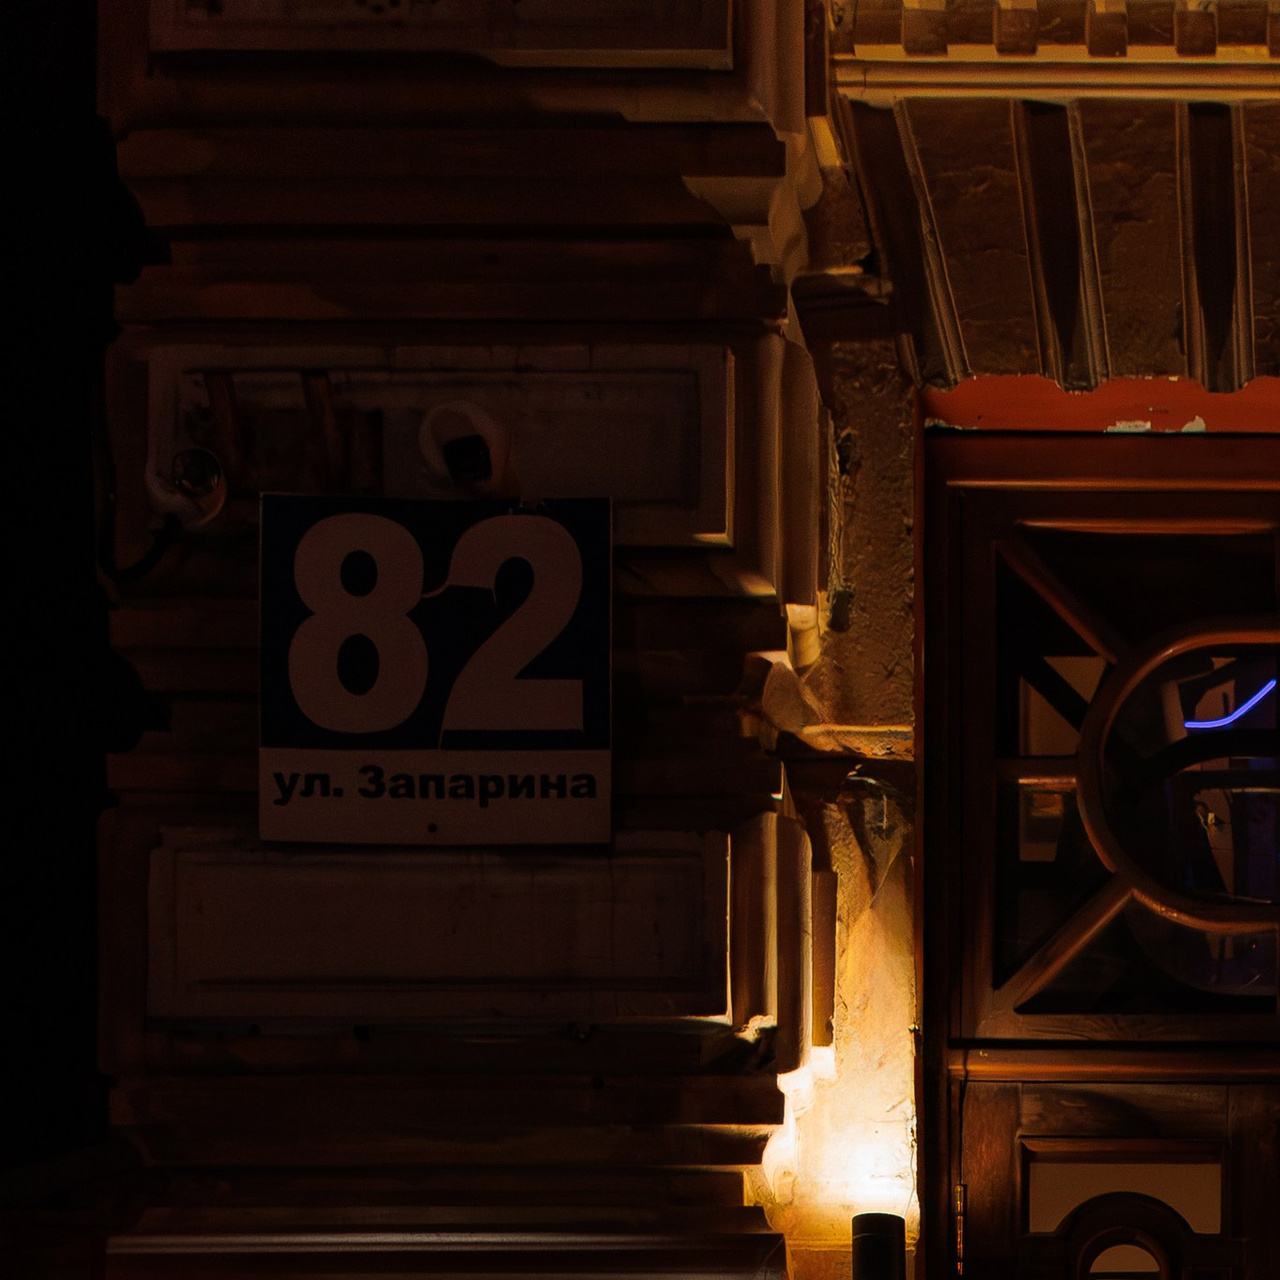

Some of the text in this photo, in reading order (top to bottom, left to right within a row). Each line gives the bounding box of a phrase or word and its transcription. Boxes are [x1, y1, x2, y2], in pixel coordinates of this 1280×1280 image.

[287, 511, 584, 734] 82
[272, 764, 598, 808] ул. Запарина
